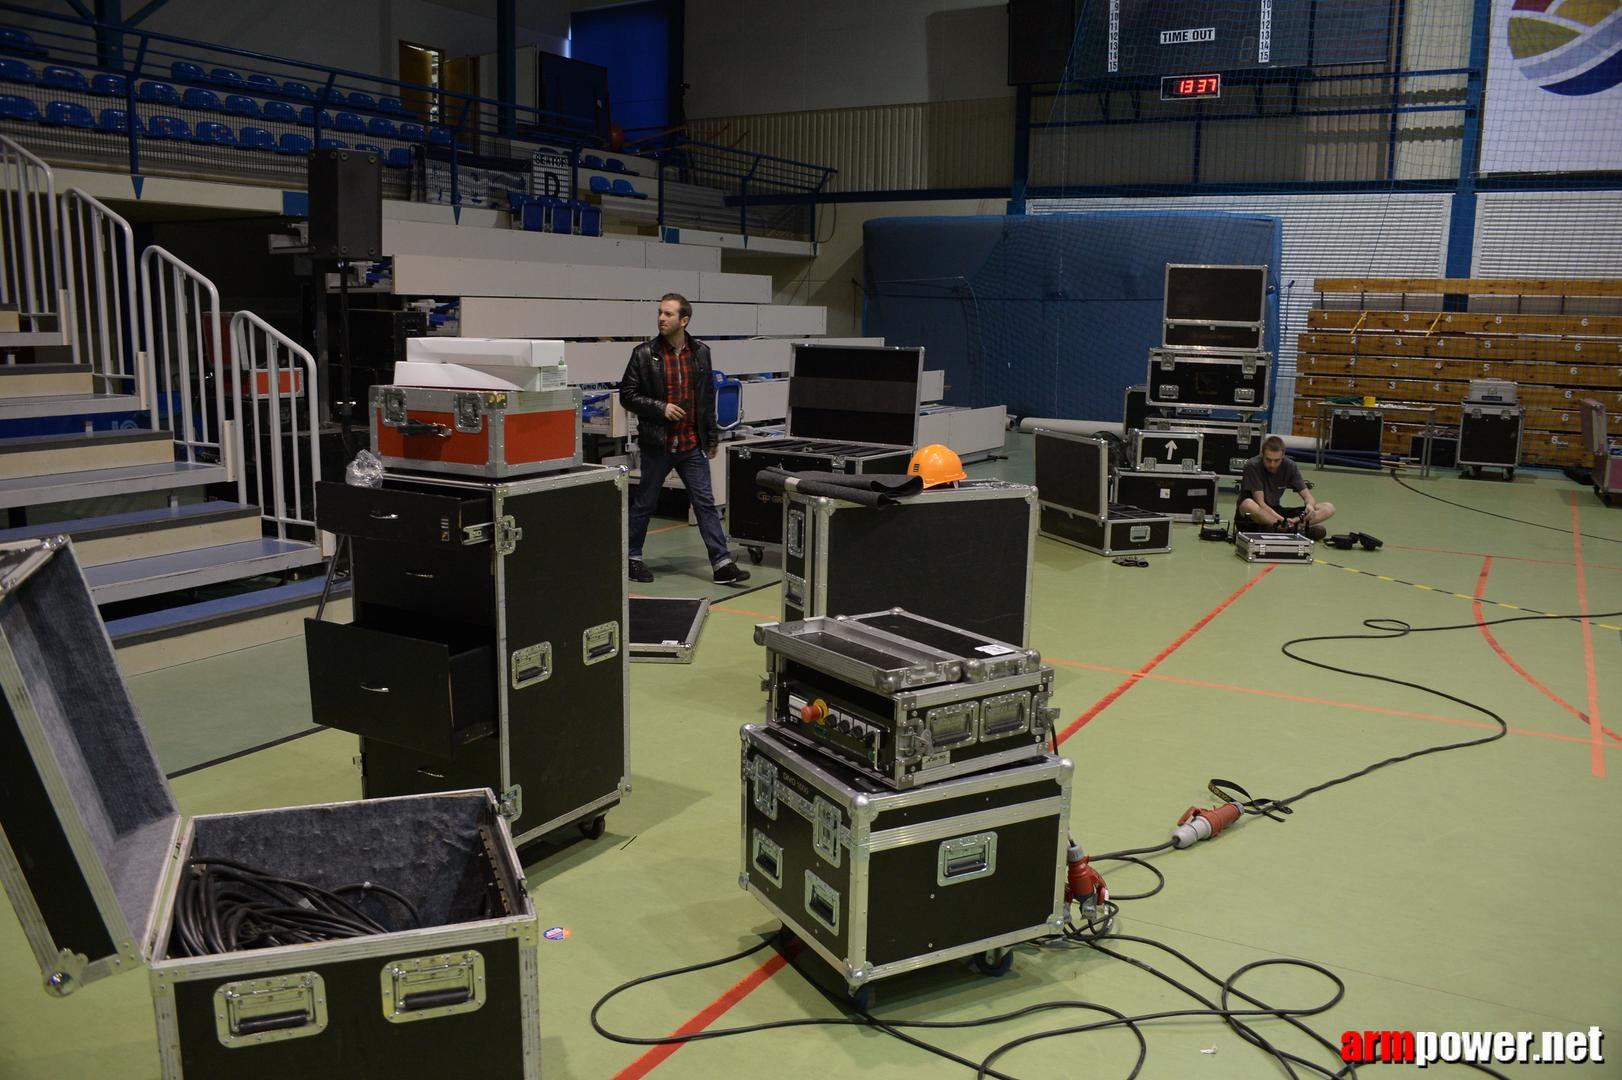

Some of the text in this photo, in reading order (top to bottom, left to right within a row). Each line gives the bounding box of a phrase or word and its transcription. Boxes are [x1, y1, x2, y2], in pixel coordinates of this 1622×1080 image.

[1115, 3, 1118, 11] 9
[1263, 0, 1271, 8] 10
[1110, 13, 1118, 21] 10
[1262, 11, 1270, 19] 11
[1262, 21, 1270, 29] 12
[1110, 32, 1118, 40] 12
[1162, 29, 1213, 42] TIME OUT
[1261, 31, 1270, 40] 13
[1110, 42, 1118, 50] 13
[1261, 41, 1269, 50] 14
[1110, 52, 1117, 60] 14
[1260, 51, 1269, 60] 15
[1110, 62, 1117, 70] 15
[1402, 314, 1409, 322] 3
[1495, 316, 1502, 325] 5
[1581, 318, 1589, 327] 6
[1395, 338, 1402, 346] 3
[1574, 343, 1582, 352] 6
[1570, 366, 1578, 376] 6
[1389, 381, 1396, 389] 3
[1390, 425, 1397, 433] 3
